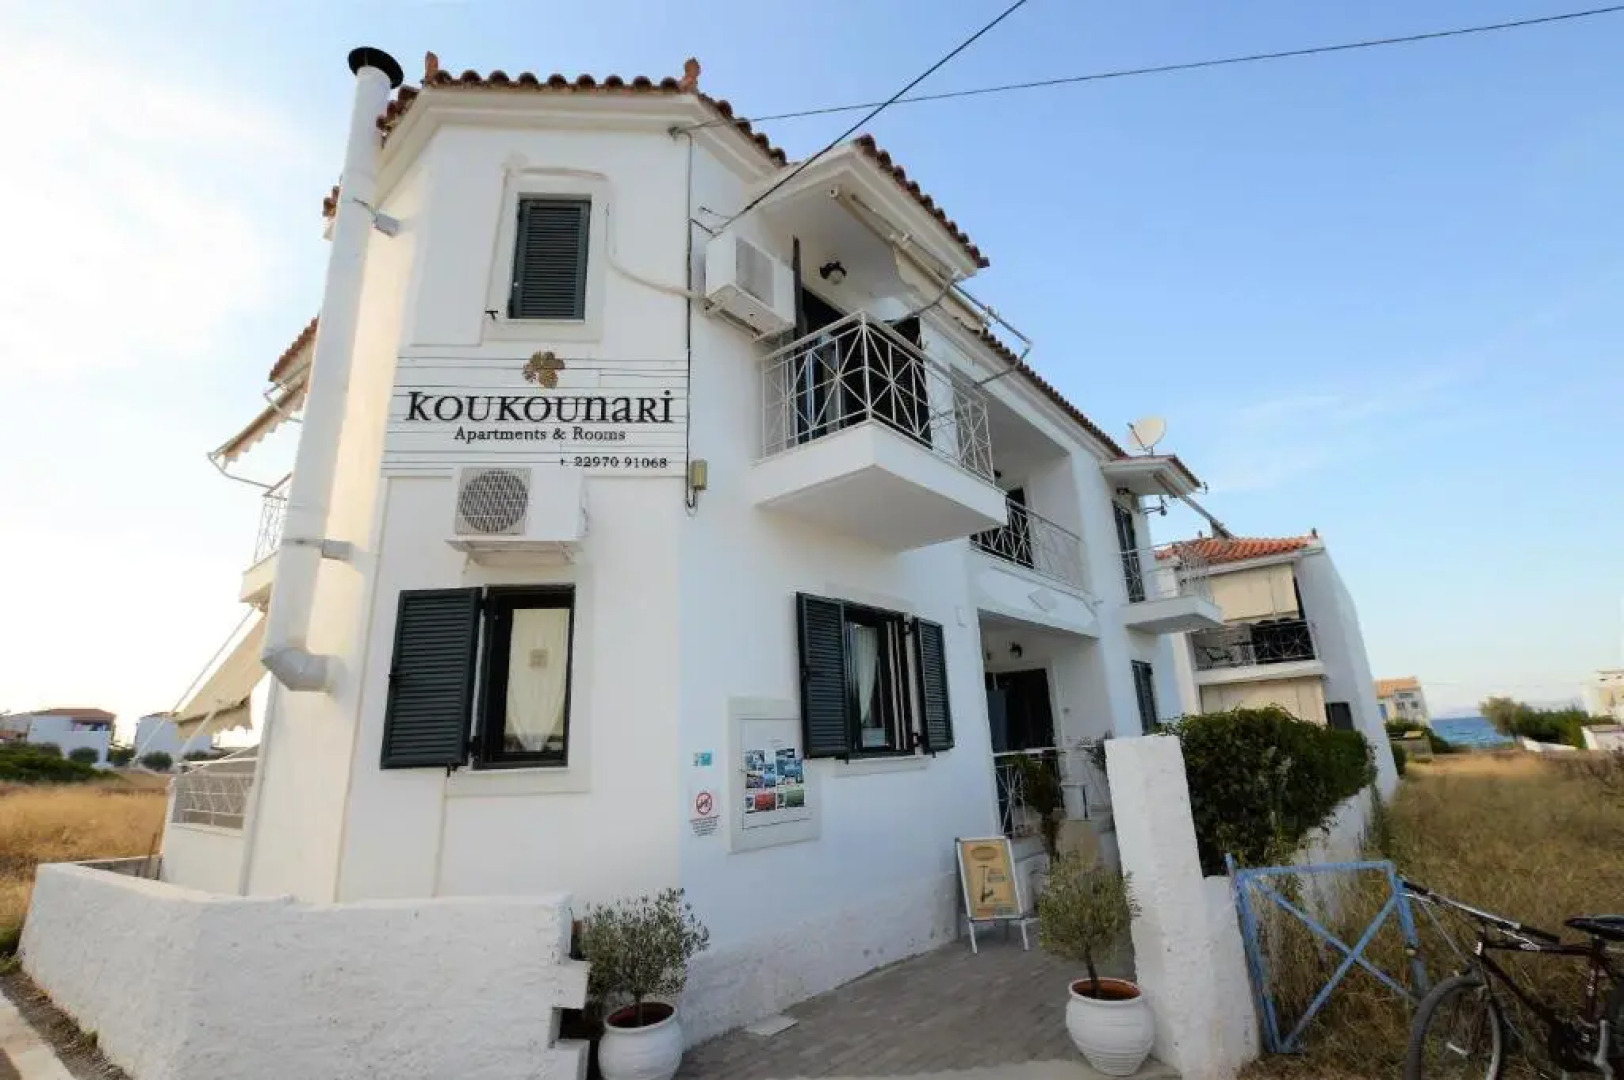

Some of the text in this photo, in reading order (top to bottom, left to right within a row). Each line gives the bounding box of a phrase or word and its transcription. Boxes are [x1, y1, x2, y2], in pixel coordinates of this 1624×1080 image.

[454, 426, 626, 444] Apartments & Rooms
[574, 456, 619, 467] 22970
[624, 457, 667, 468] 91068
